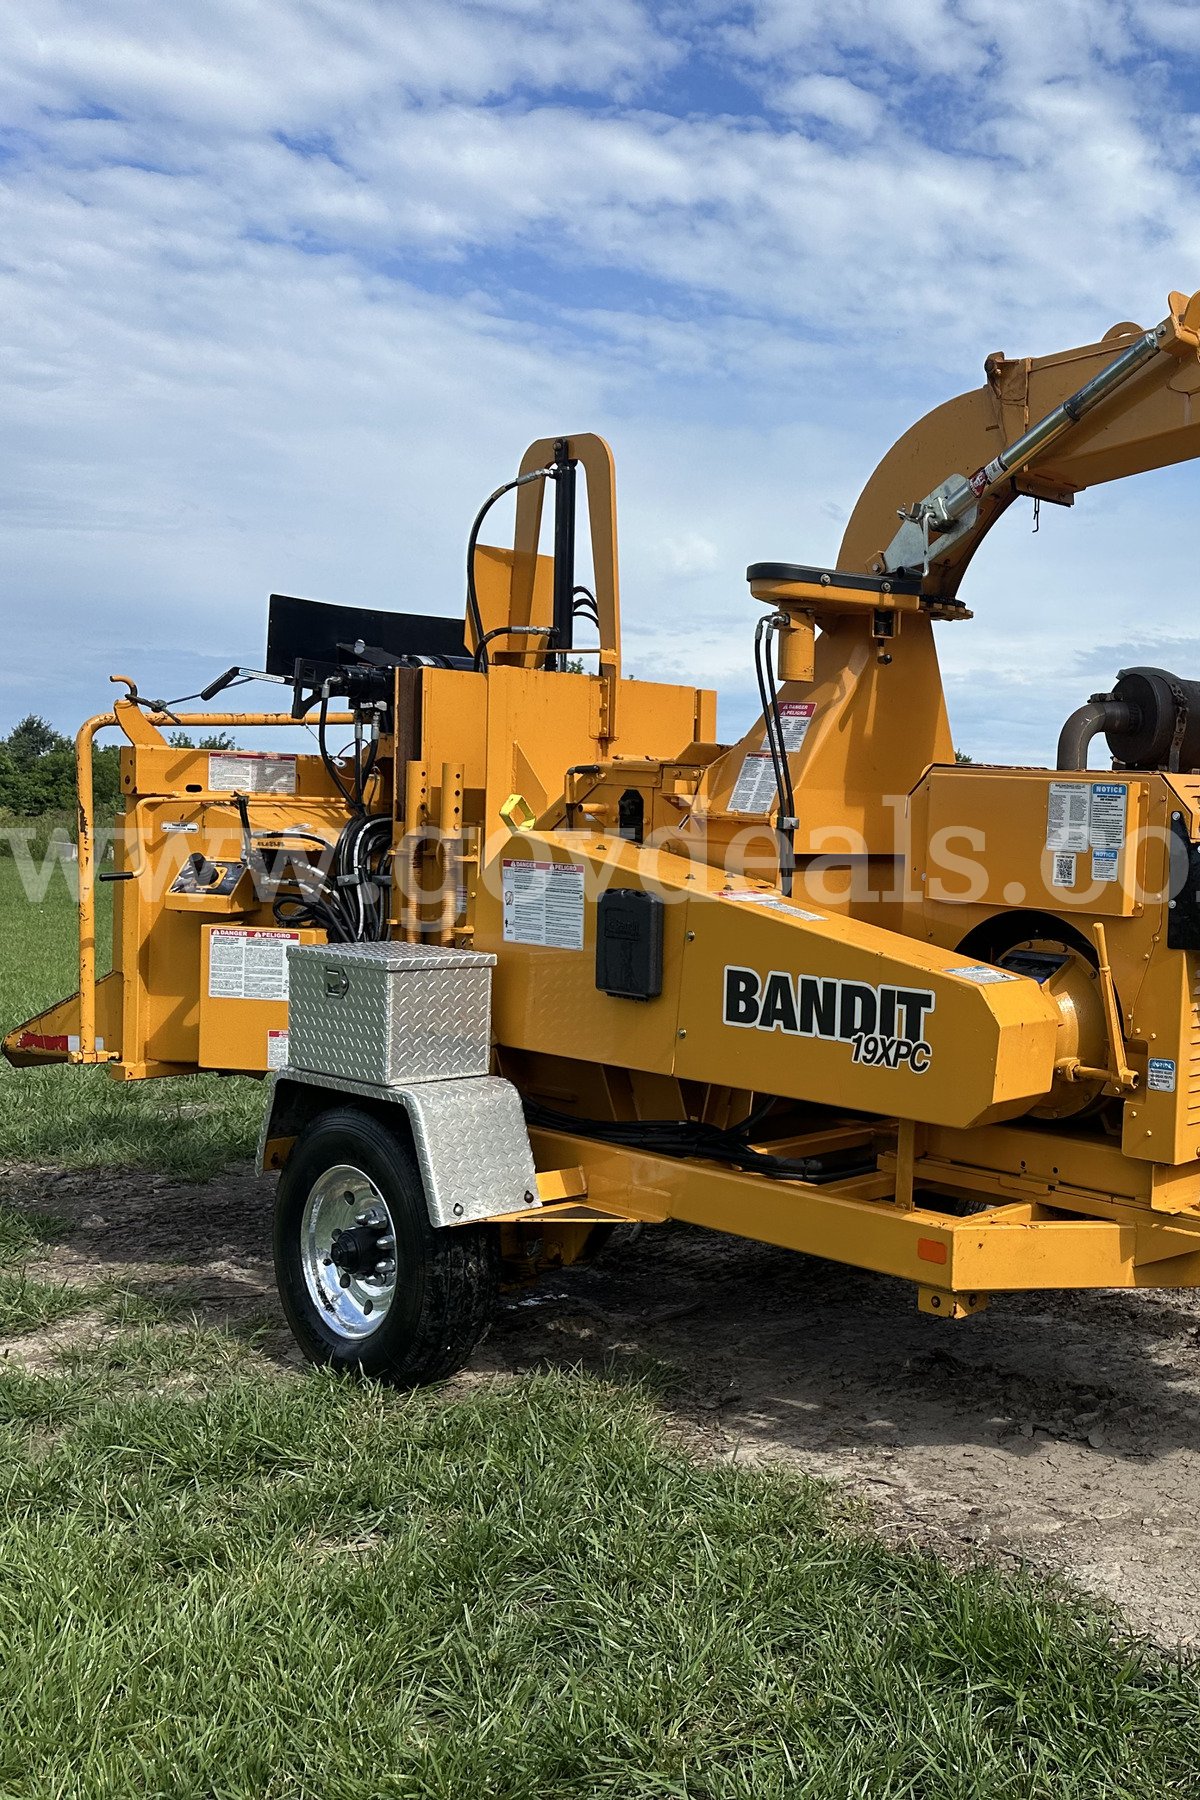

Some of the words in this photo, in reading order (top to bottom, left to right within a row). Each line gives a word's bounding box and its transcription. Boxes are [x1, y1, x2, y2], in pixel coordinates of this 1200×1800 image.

[1096, 785, 1123, 794] NOTICE
[554, 864, 577, 872] PELIGRO
[723, 965, 936, 1042] BANDIT
[850, 1032, 933, 1074] 19XPC
